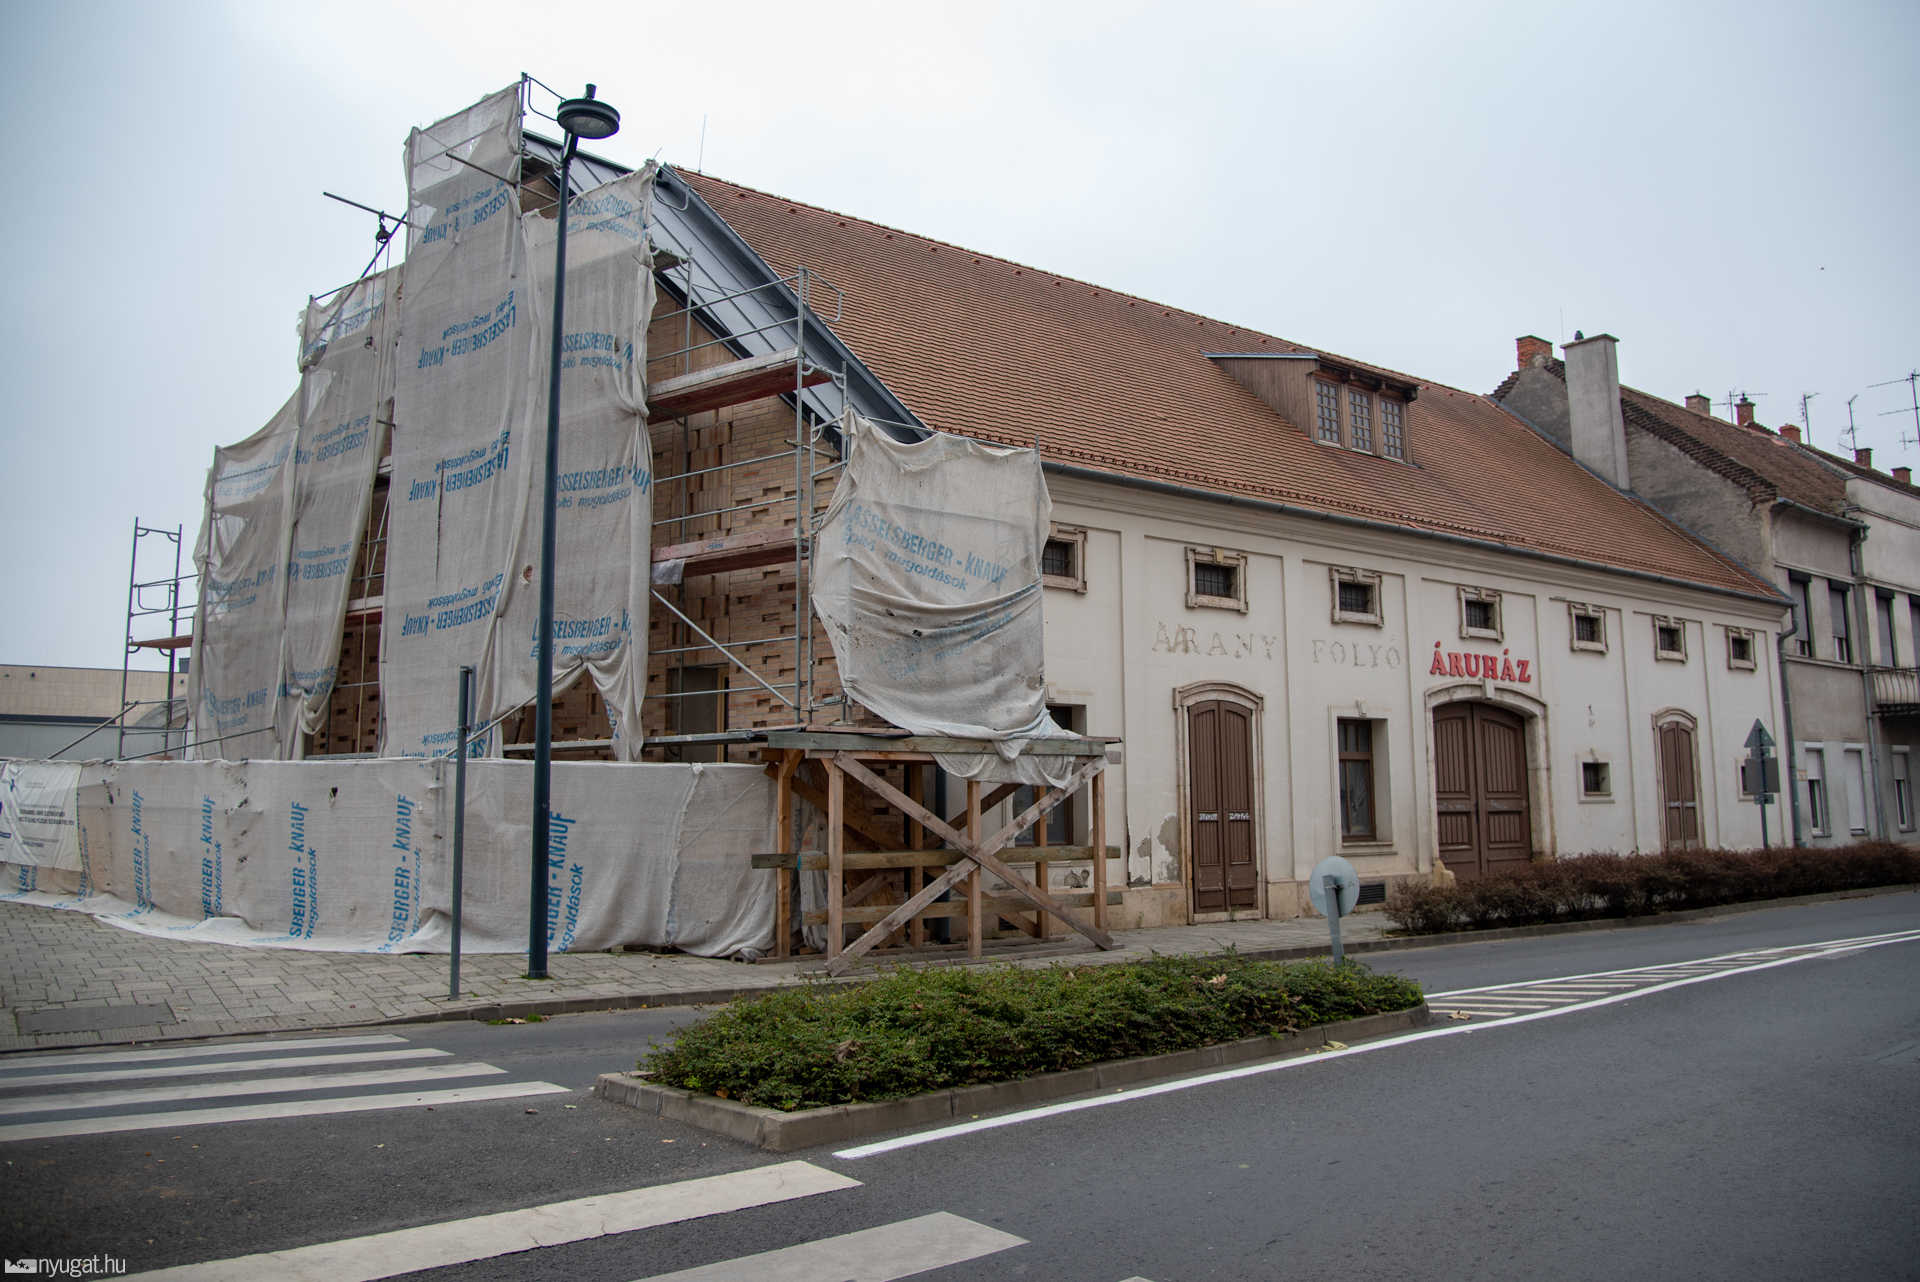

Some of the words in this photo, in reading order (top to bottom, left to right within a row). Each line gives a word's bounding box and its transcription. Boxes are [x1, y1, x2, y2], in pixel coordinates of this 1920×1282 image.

[845, 502, 953, 566] LASSELSBERGER
[964, 551, 1008, 591] KNAUF
[884, 550, 968, 591] megoldások
[401, 613, 430, 637] KNAUF
[1430, 640, 1532, 682] ÁRUHÁZ
[200, 793, 216, 845] KNAUF
[287, 800, 309, 852] KNAUF
[392, 793, 415, 851] KNAUF
[547, 811, 576, 869] KNAUF
